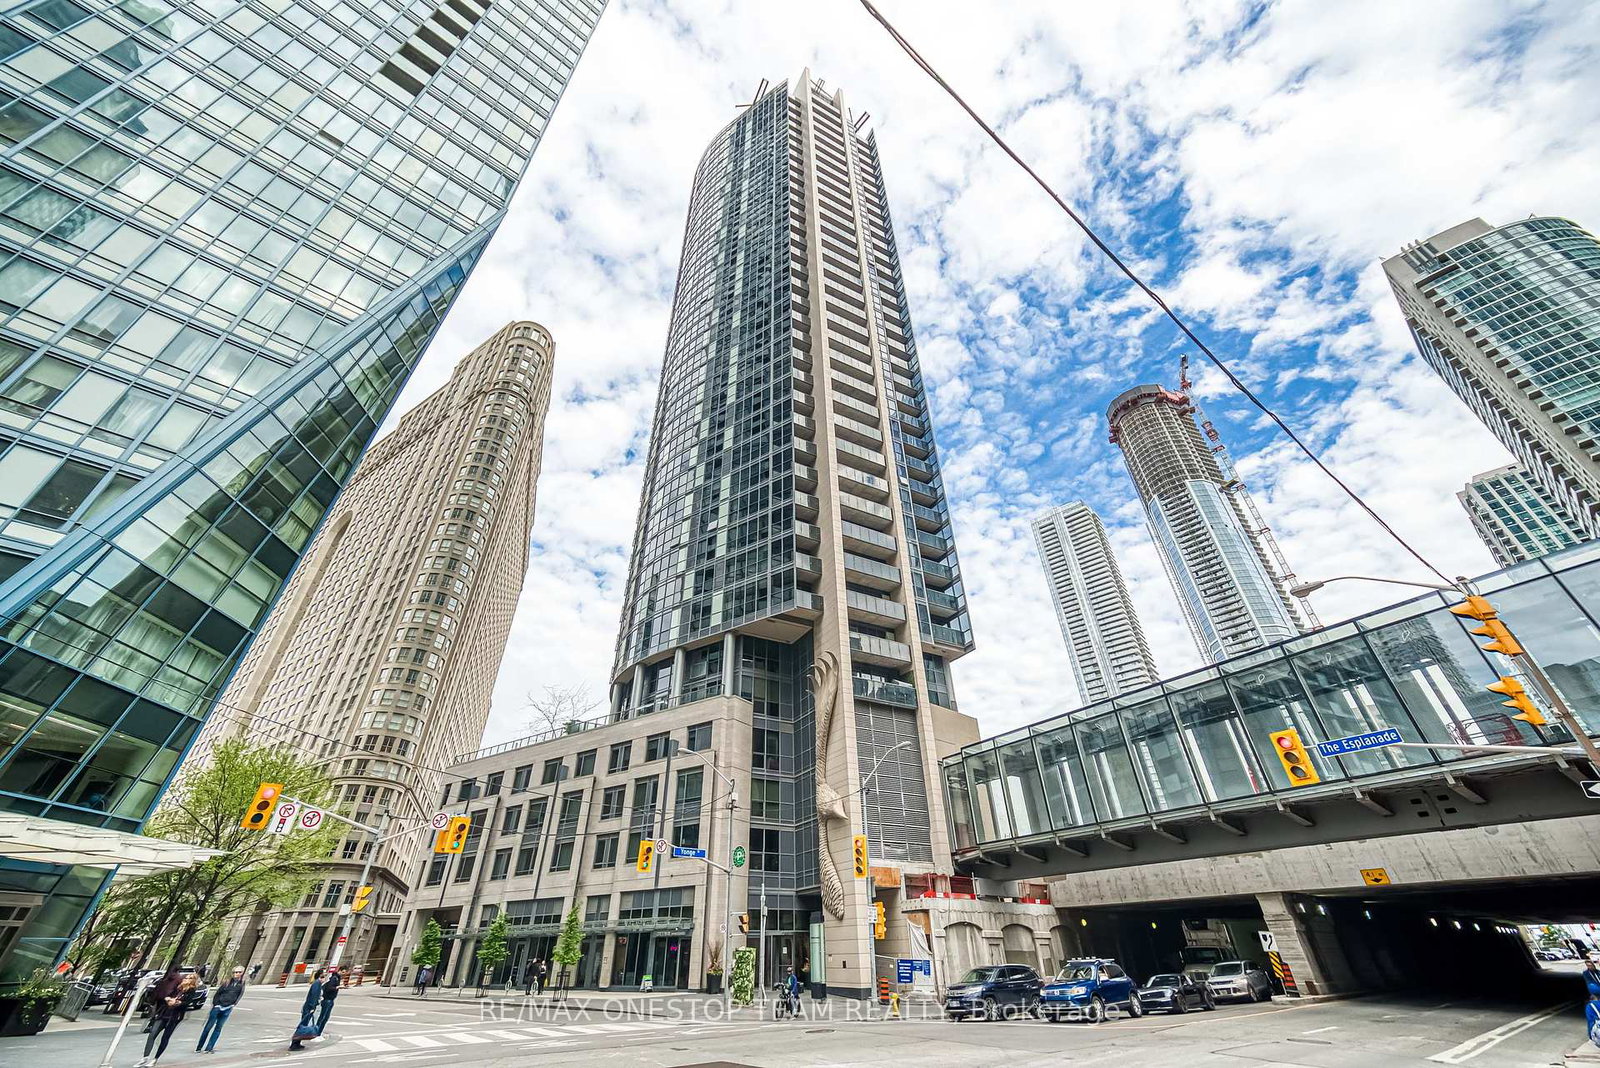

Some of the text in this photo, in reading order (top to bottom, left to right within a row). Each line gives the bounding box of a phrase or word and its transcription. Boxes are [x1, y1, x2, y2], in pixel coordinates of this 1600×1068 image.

[1320, 732, 1398, 753] The Esplanade
[681, 848, 696, 857] Yonge
